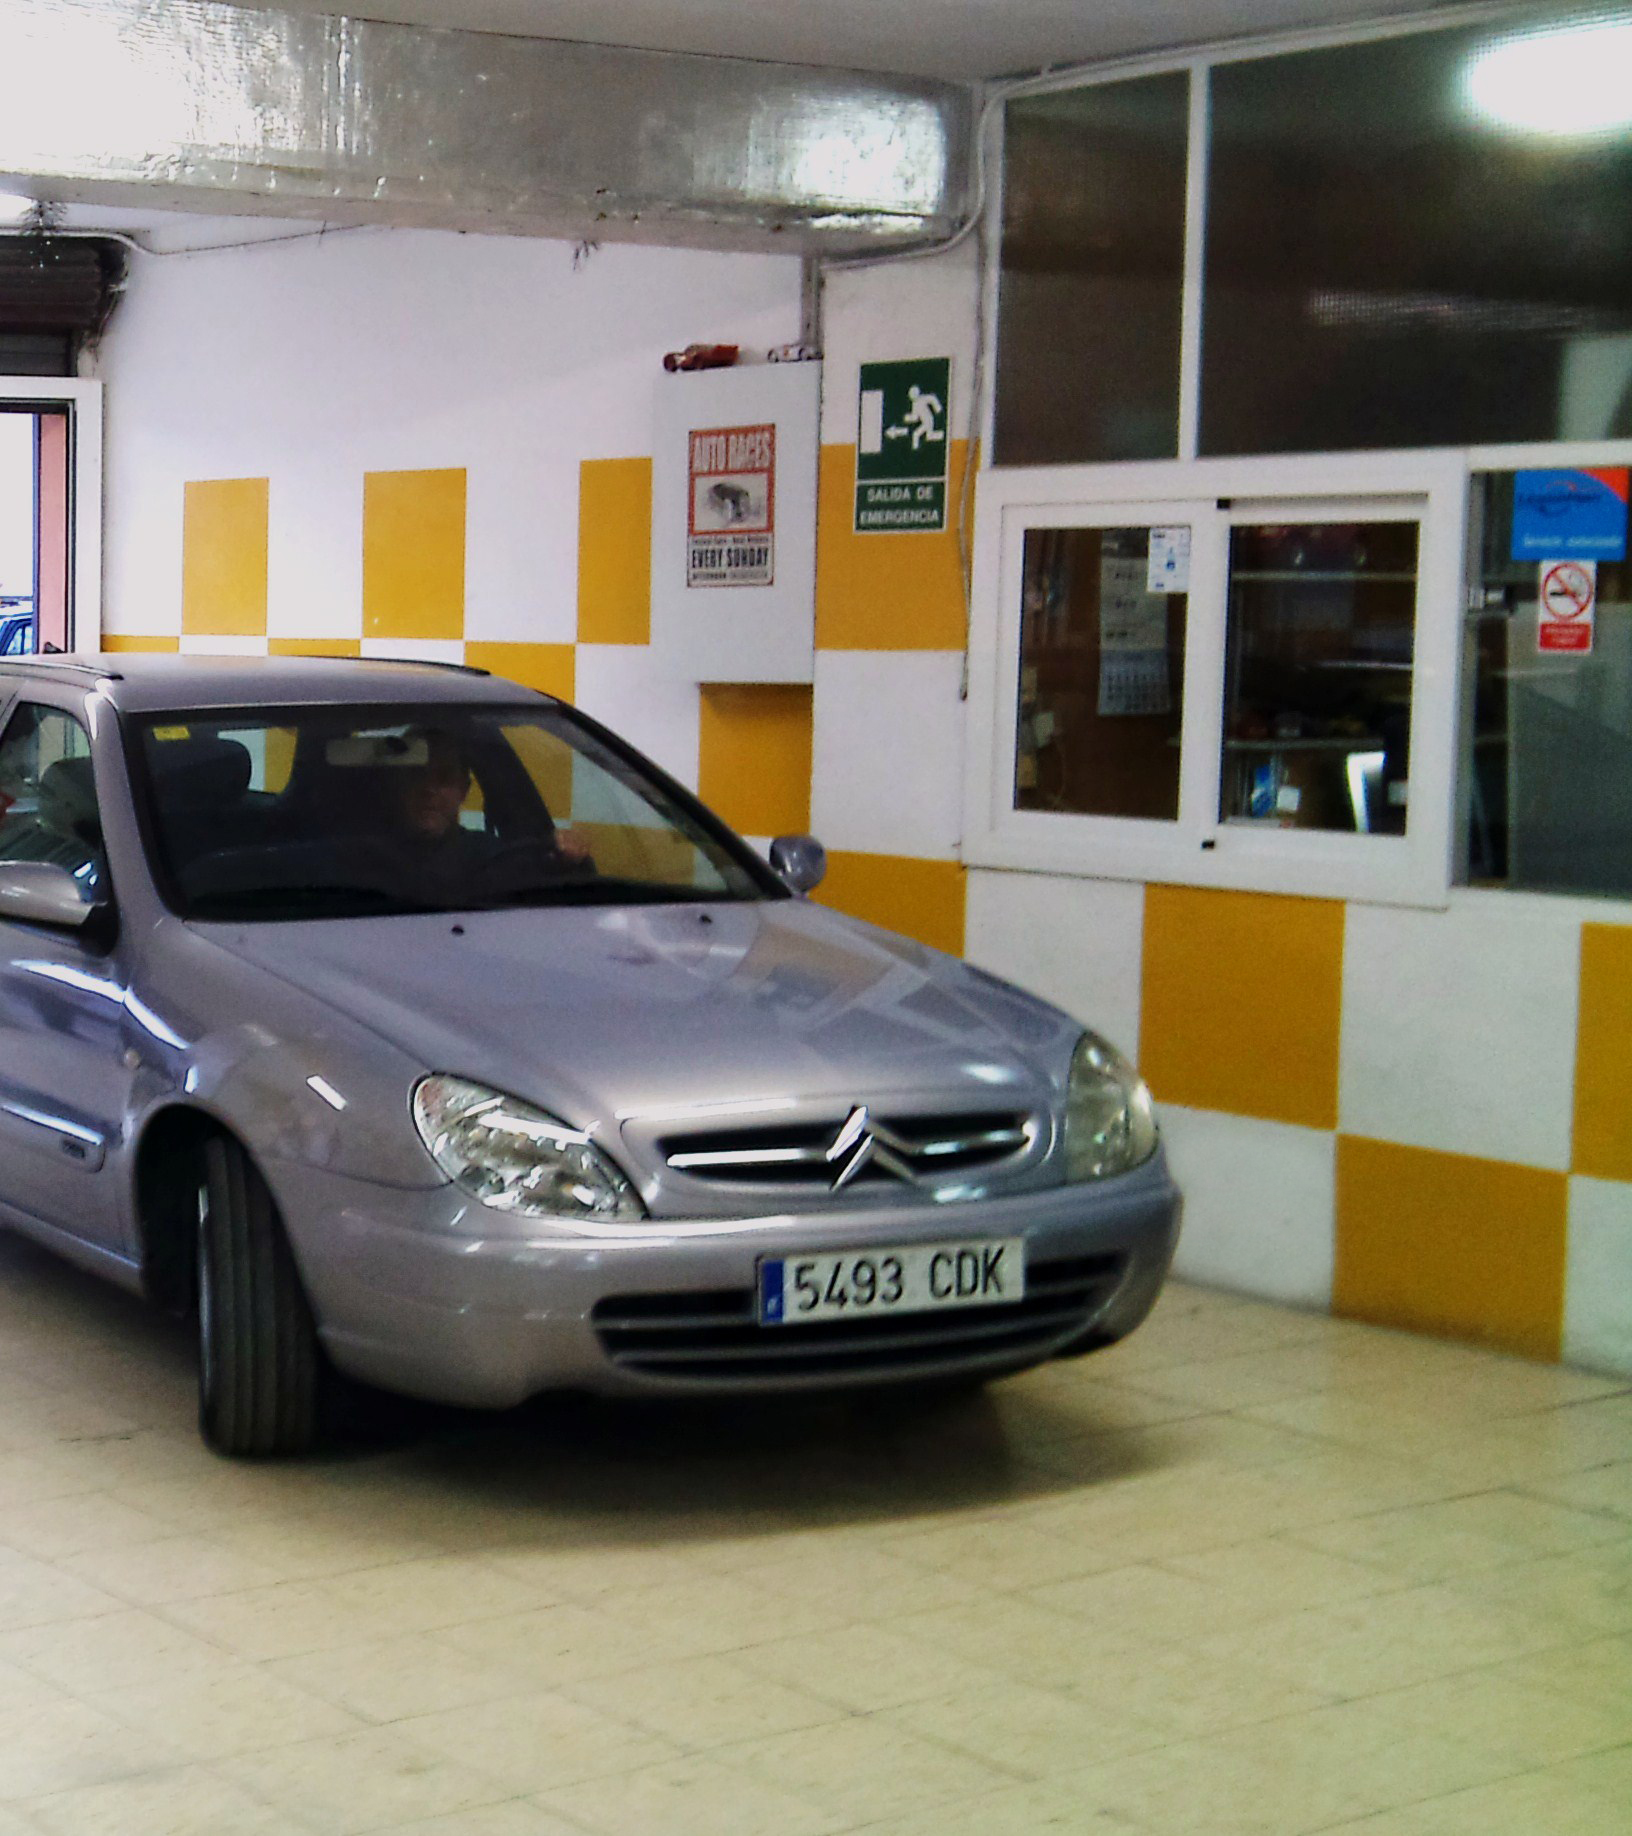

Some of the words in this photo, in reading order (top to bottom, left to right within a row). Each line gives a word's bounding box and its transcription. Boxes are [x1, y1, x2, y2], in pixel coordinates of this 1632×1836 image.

[693, 434, 727, 472] AUTO
[867, 485, 911, 502] SALIDA
[916, 483, 934, 500] DE
[859, 508, 940, 525] EMERGENCIA
[692, 547, 723, 568] EVERY
[727, 546, 769, 568] SUNDAY
[794, 1256, 904, 1312] 5493
[928, 1245, 1006, 1299] CDK
